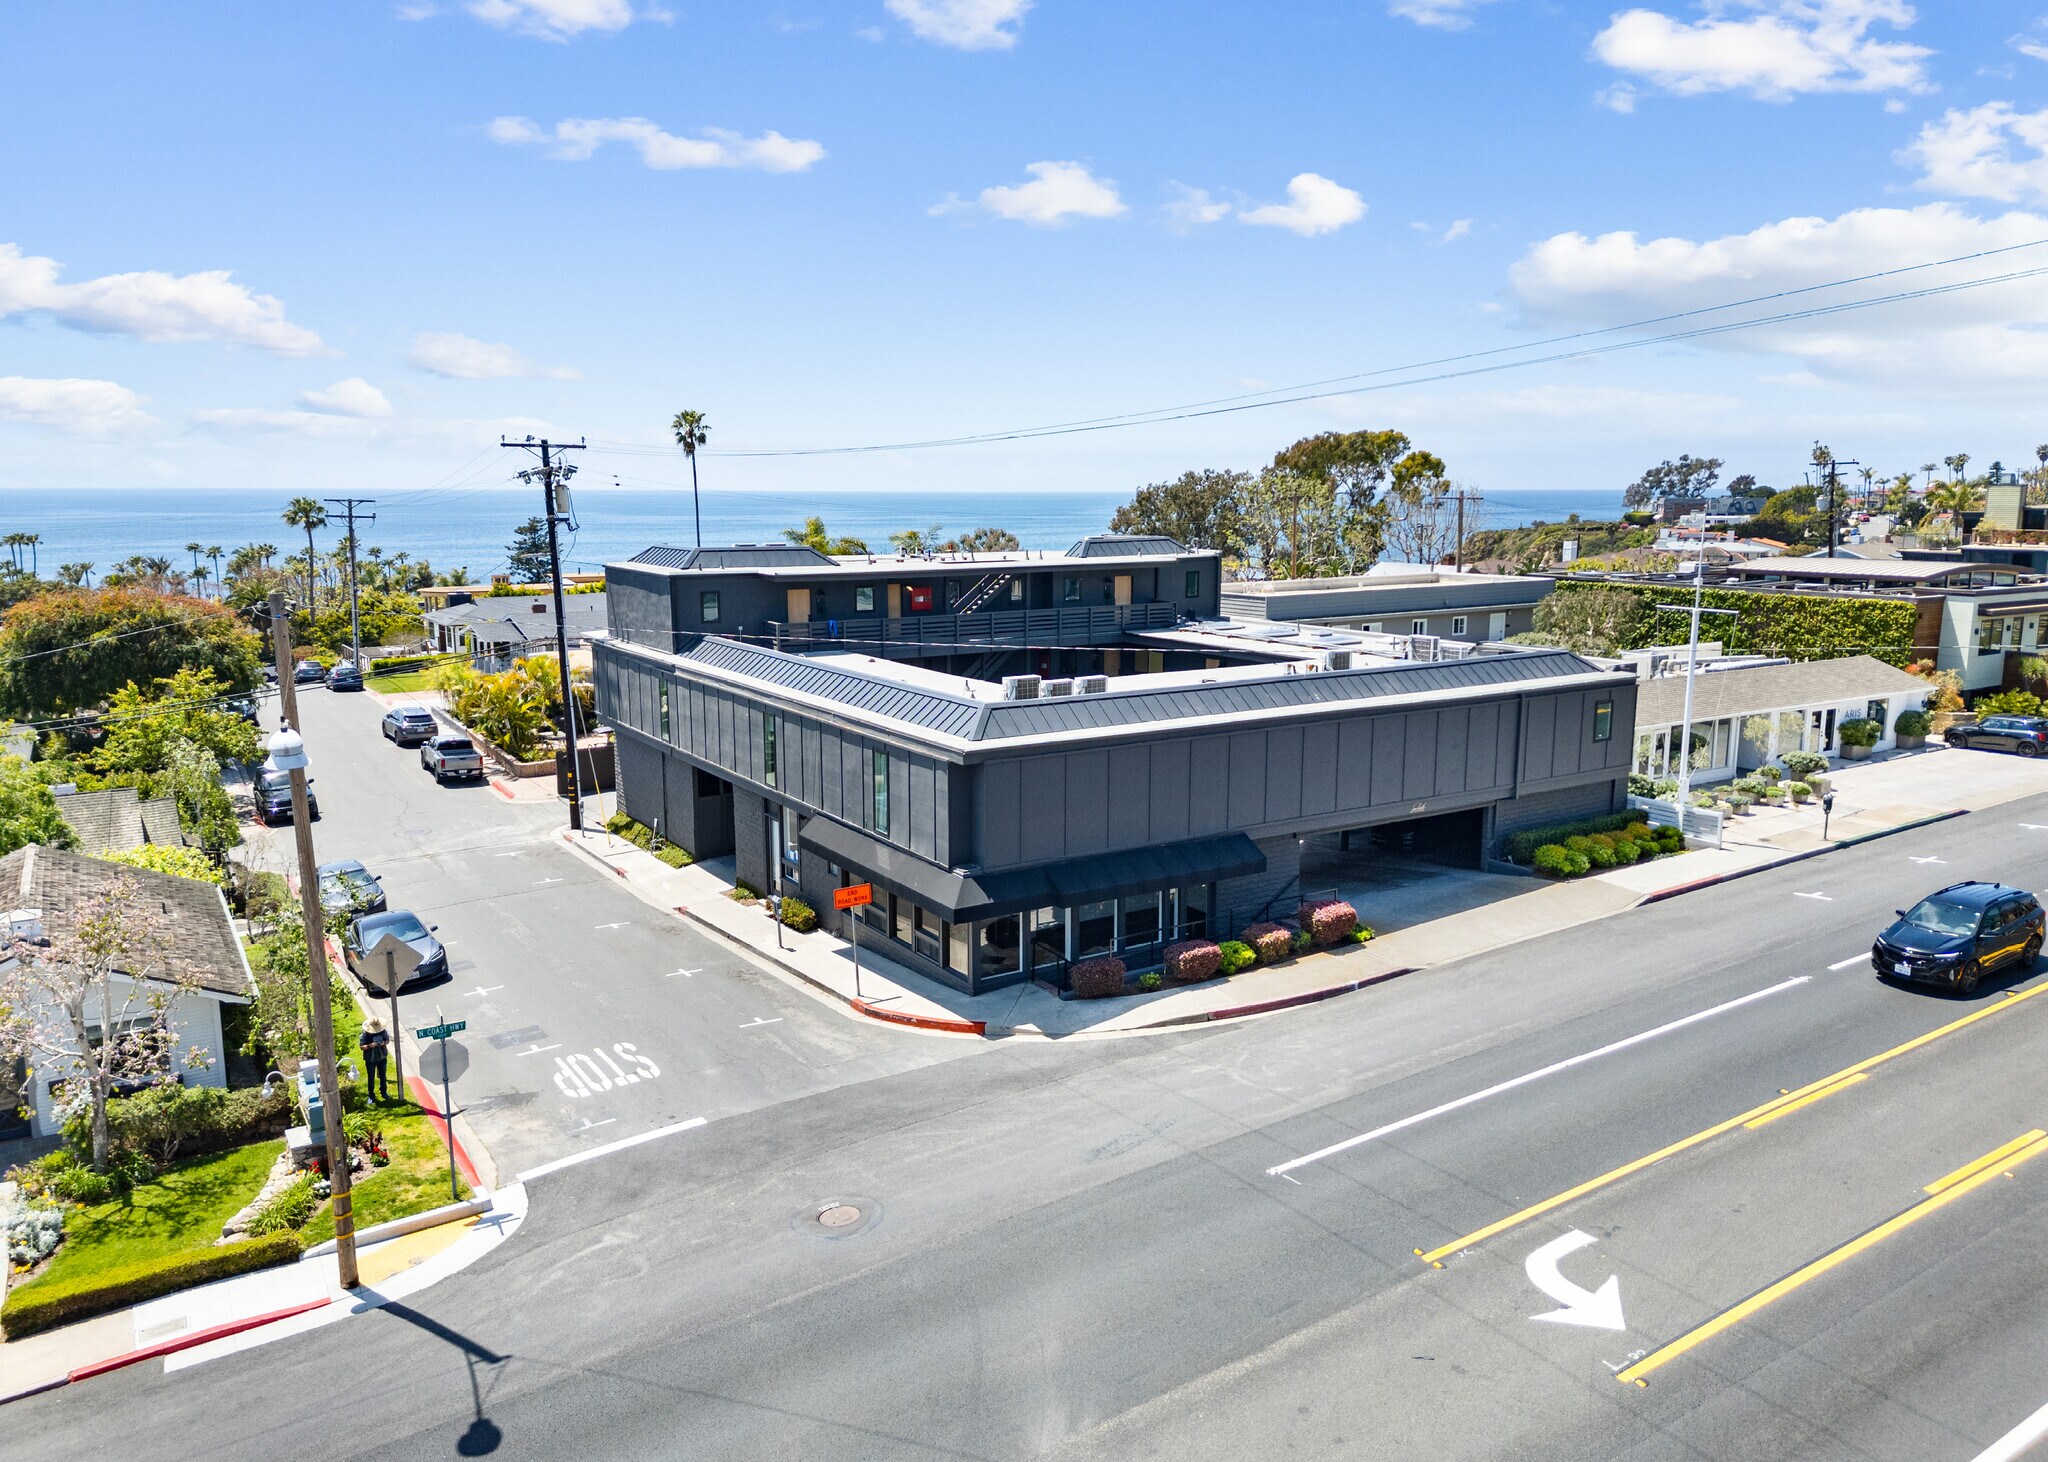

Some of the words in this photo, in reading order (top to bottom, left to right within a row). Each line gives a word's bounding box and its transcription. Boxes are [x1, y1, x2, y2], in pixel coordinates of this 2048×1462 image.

[1844, 709, 1861, 718] ARIS
[427, 1025, 447, 1036] COAST
[450, 1022, 464, 1031] HWY
[553, 1042, 661, 1098] STOP
